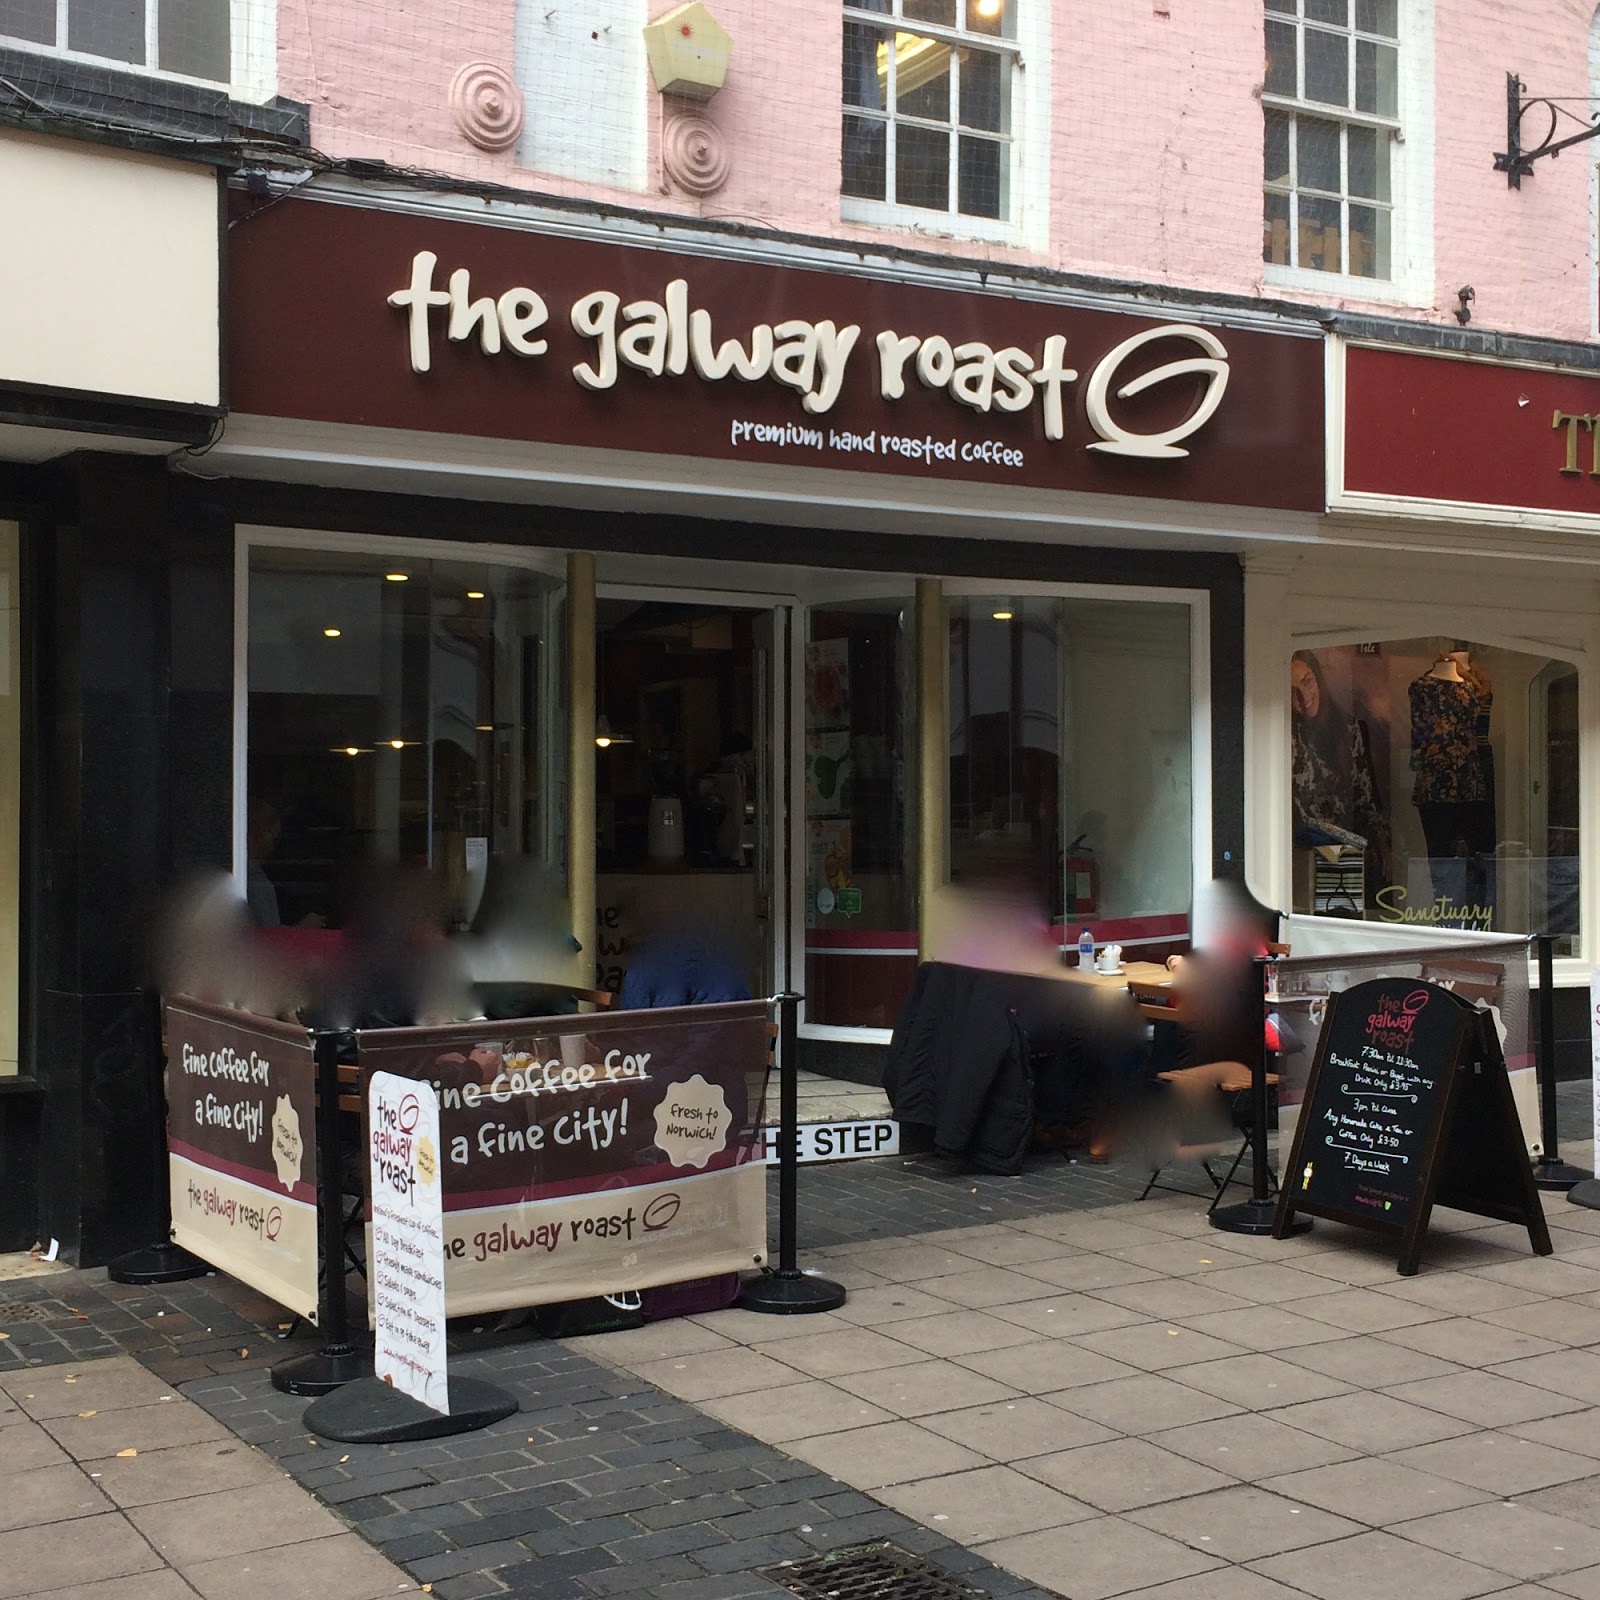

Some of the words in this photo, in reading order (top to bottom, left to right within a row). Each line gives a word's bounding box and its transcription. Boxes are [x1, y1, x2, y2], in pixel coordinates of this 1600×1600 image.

[387, 250, 549, 374] the
[571, 278, 861, 415] galway
[876, 330, 1078, 440] roast
[731, 419, 823, 450] premium
[829, 428, 875, 453] hand
[880, 431, 956, 465] roasted
[961, 440, 1024, 467] coffee
[1376, 885, 1493, 932] Sanctuary
[1366, 1010, 1416, 1034] galway
[1377, 993, 1400, 1013] the
[1372, 1030, 1415, 1056] roast
[182, 1042, 209, 1077] fine
[209, 1047, 250, 1083] coffee
[250, 1050, 270, 1088] for
[425, 1078, 481, 1110] ine
[490, 1059, 597, 1103] coffee
[604, 1049, 652, 1083] for
[195, 1099, 204, 1126] a
[205, 1092, 232, 1129] fine
[376, 1095, 397, 1130] the
[705, 1107, 719, 1124] to
[1323, 1108, 1339, 1127] Any
[373, 1126, 412, 1167] galway
[451, 1135, 469, 1165] a
[478, 1121, 545, 1158] fine
[666, 1122, 717, 1140] Norwich!
[814, 1124, 893, 1156] STEP
[1344, 1151, 1352, 1163] 7
[1351, 1154, 1367, 1171] Days
[379, 1157, 416, 1208] roast
[188, 1178, 202, 1209] the
[203, 1186, 237, 1226] galway
[239, 1203, 265, 1241] roast
[472, 1212, 563, 1262] galway
[570, 1207, 637, 1243] roast
